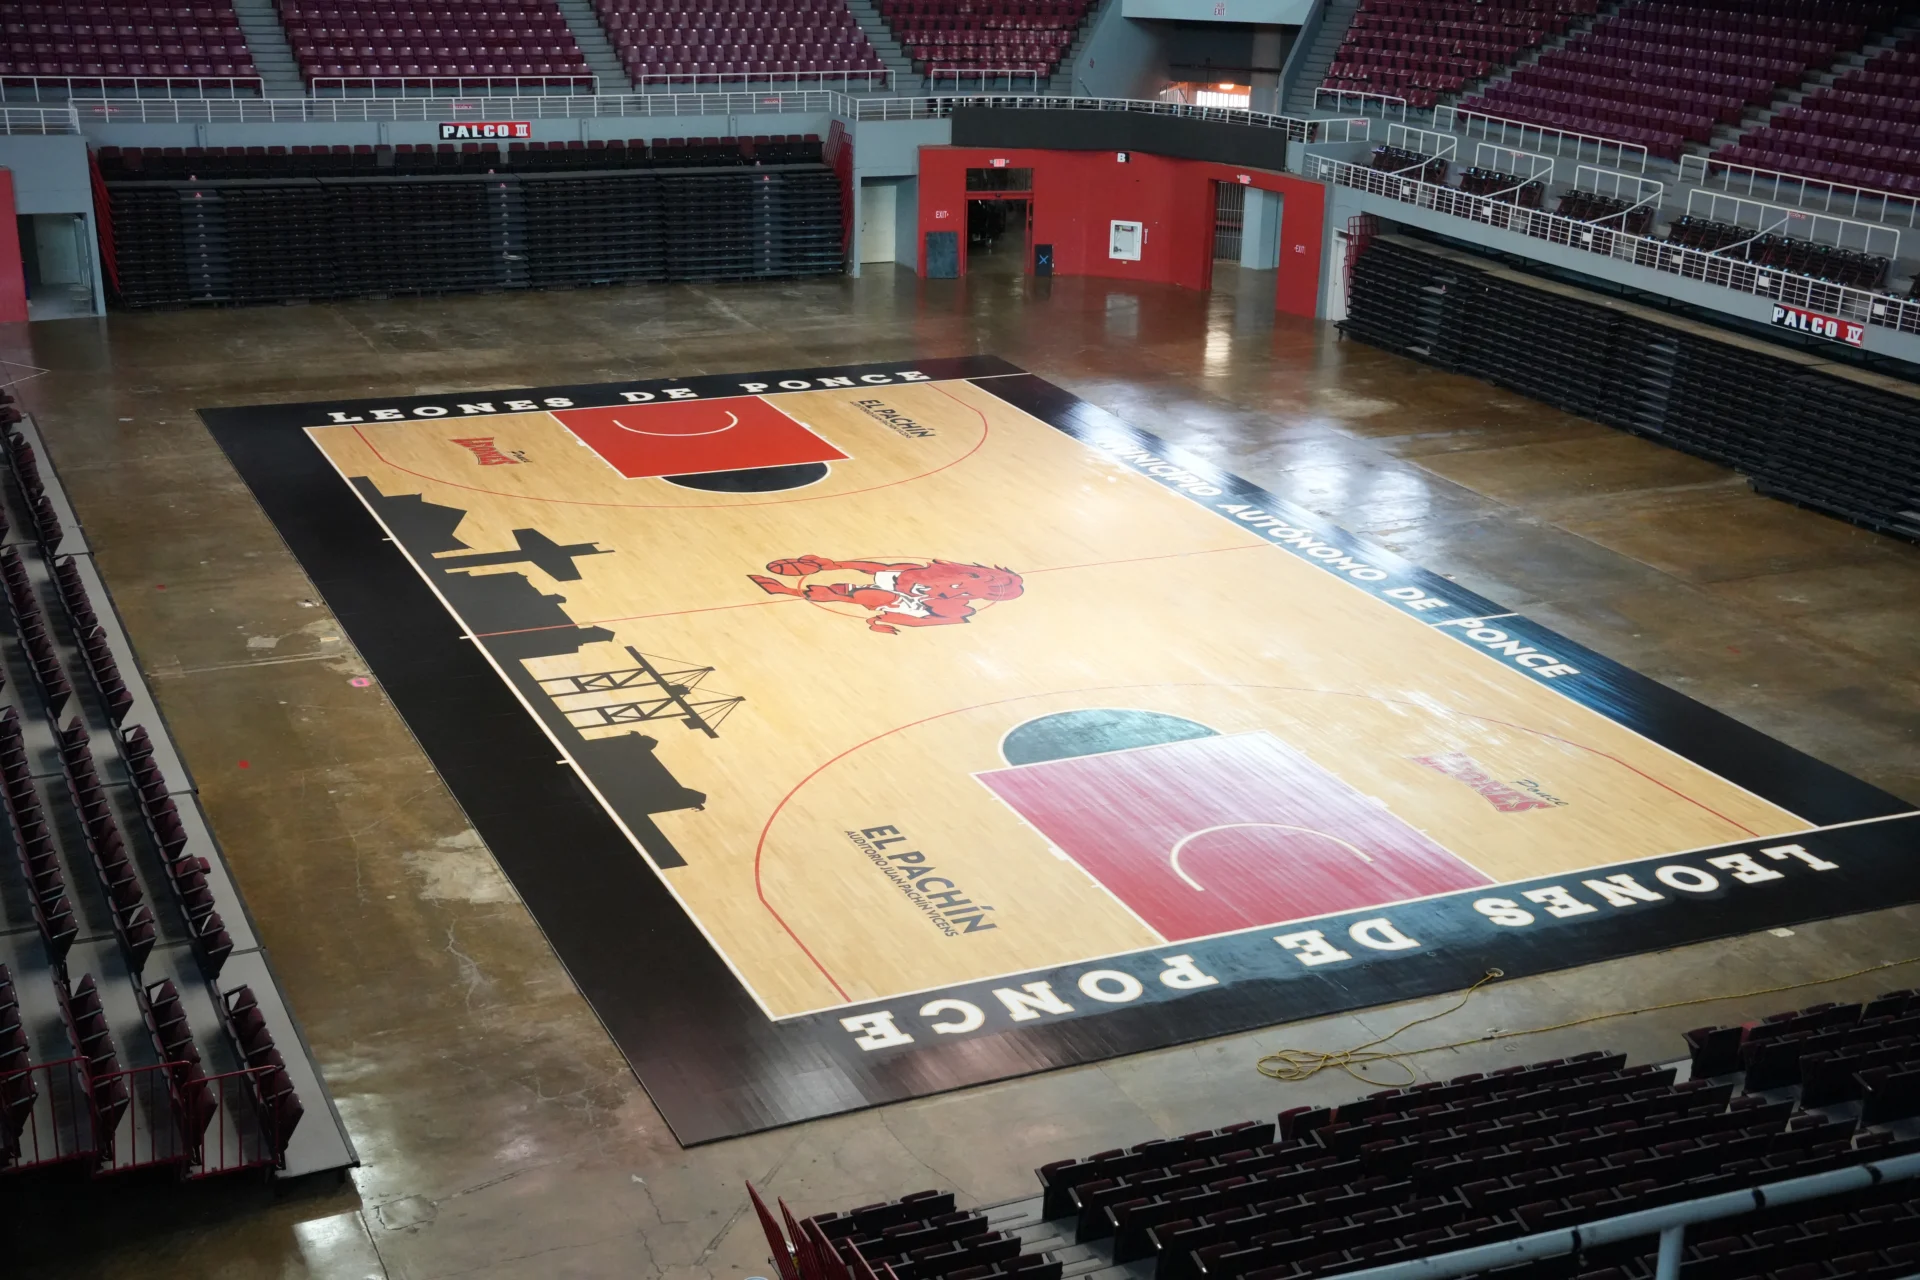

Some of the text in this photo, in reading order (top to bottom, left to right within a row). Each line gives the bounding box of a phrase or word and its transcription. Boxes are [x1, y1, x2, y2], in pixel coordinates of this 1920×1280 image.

[443, 124, 528, 138] PALCO III
[1117, 152, 1126, 162] B
[936, 210, 947, 218] EXIT
[1772, 306, 1863, 344] PALCO IV
[328, 370, 932, 423] LEONES DE PONCE
[858, 399, 885, 409] EL
[873, 408, 936, 438] PACHÍN
[1216, 504, 1388, 581] AUTÓNOMO
[1383, 586, 1450, 611] DE
[1440, 617, 1581, 679] PONCE
[1509, 779, 1570, 807] Ponce
[844, 830, 959, 937] AUDITORIO JUAN PACHÍN VICENS
[860, 825, 997, 934] EL PACHÍN
[839, 843, 1840, 1051] LEONES DE PONCE
